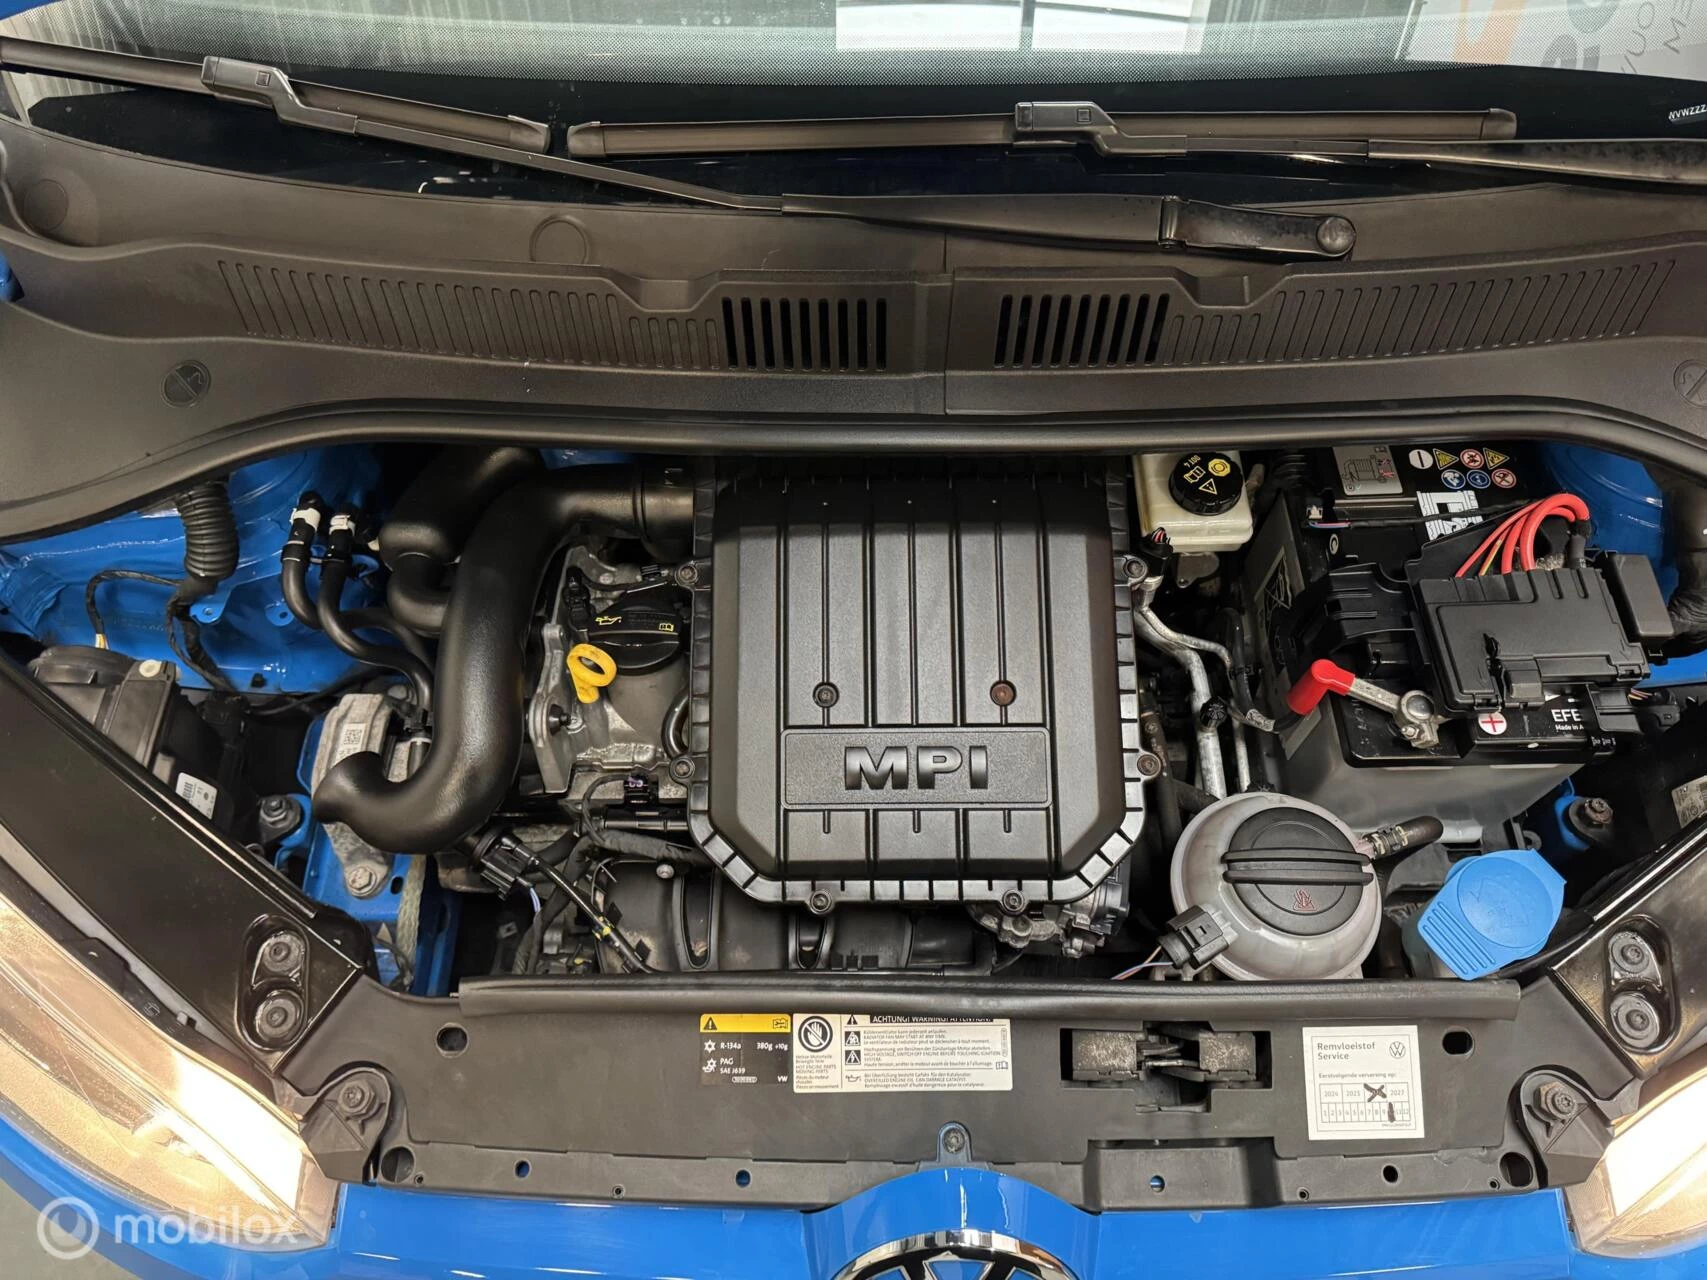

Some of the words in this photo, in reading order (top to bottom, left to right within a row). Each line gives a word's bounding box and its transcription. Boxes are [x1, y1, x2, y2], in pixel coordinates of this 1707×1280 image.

[844, 745, 988, 790] MPI
[756, 1042, 773, 1051] 380g
[1317, 1041, 1376, 1051] Remvloeistof
[1317, 1051, 1349, 1060] Service
